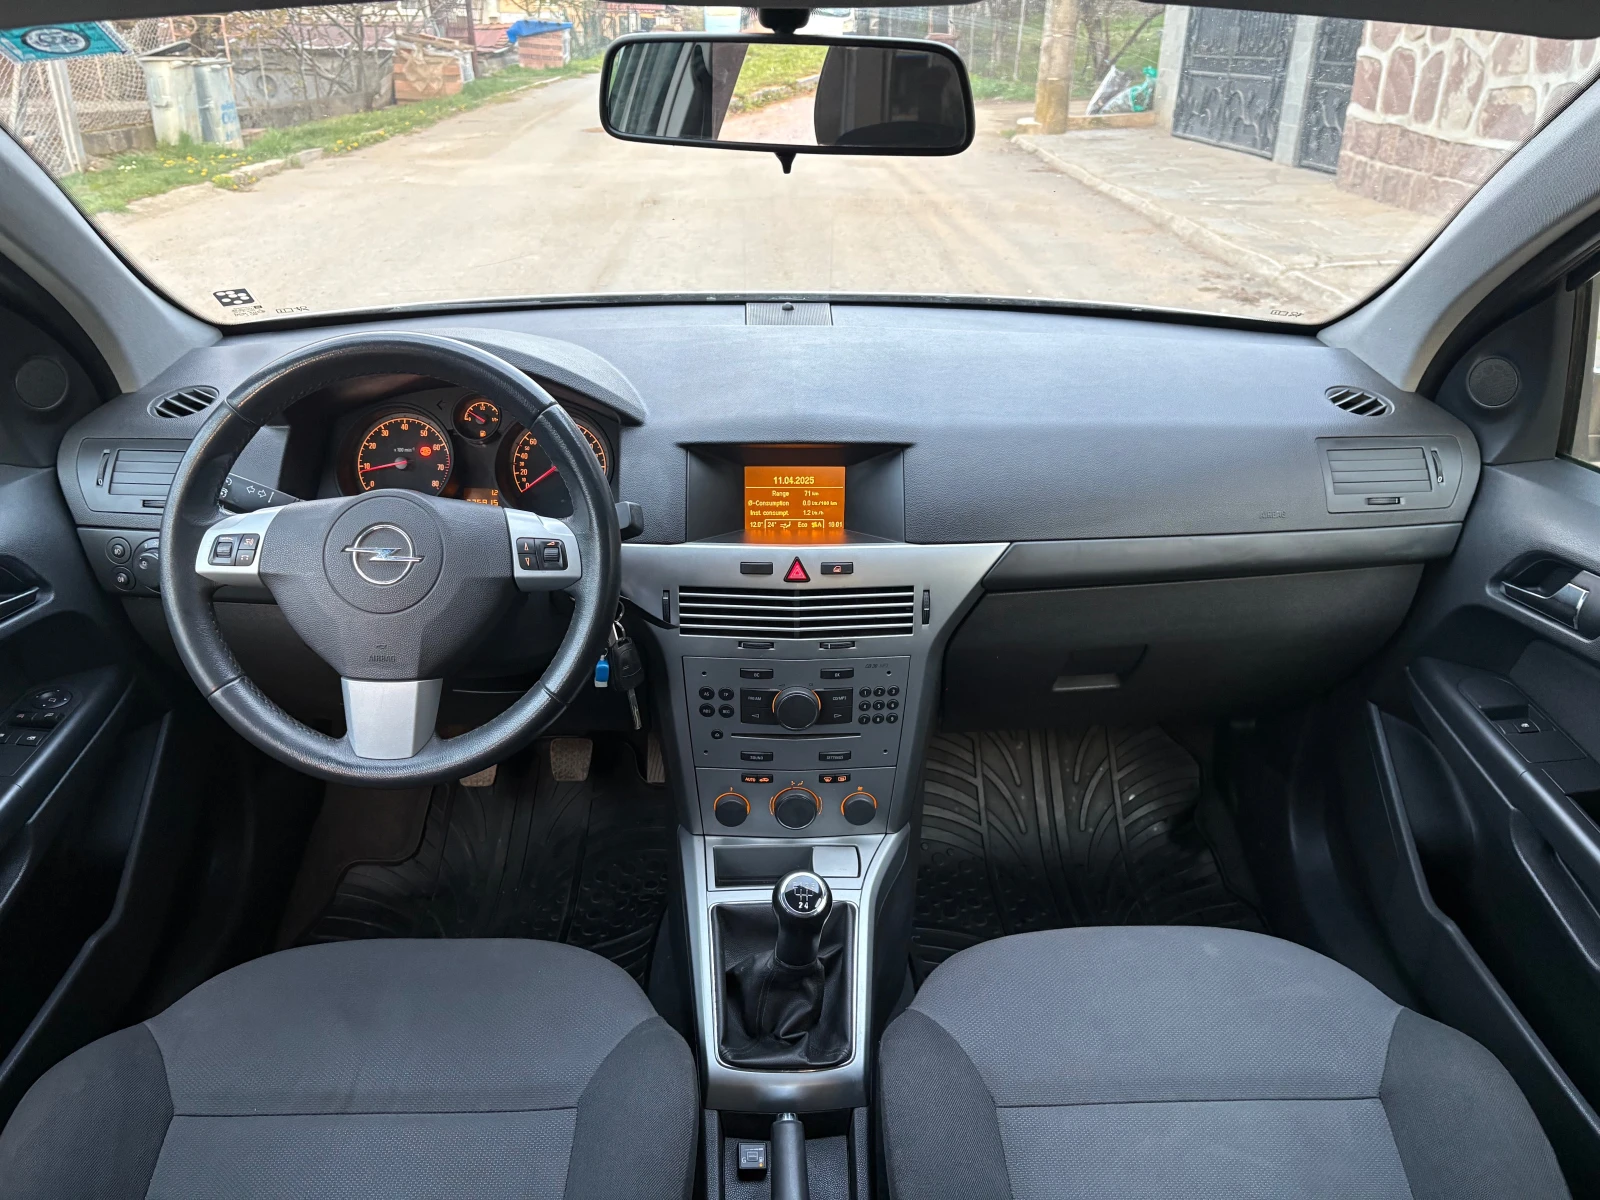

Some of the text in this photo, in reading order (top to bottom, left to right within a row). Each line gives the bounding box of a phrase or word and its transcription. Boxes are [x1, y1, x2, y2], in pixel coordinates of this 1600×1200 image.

[400, 423, 409, 431] 40
[381, 429, 389, 437] 30
[363, 462, 371, 470] 10
[773, 476, 815, 484] 11.04.2025
[771, 490, 790, 498] Range
